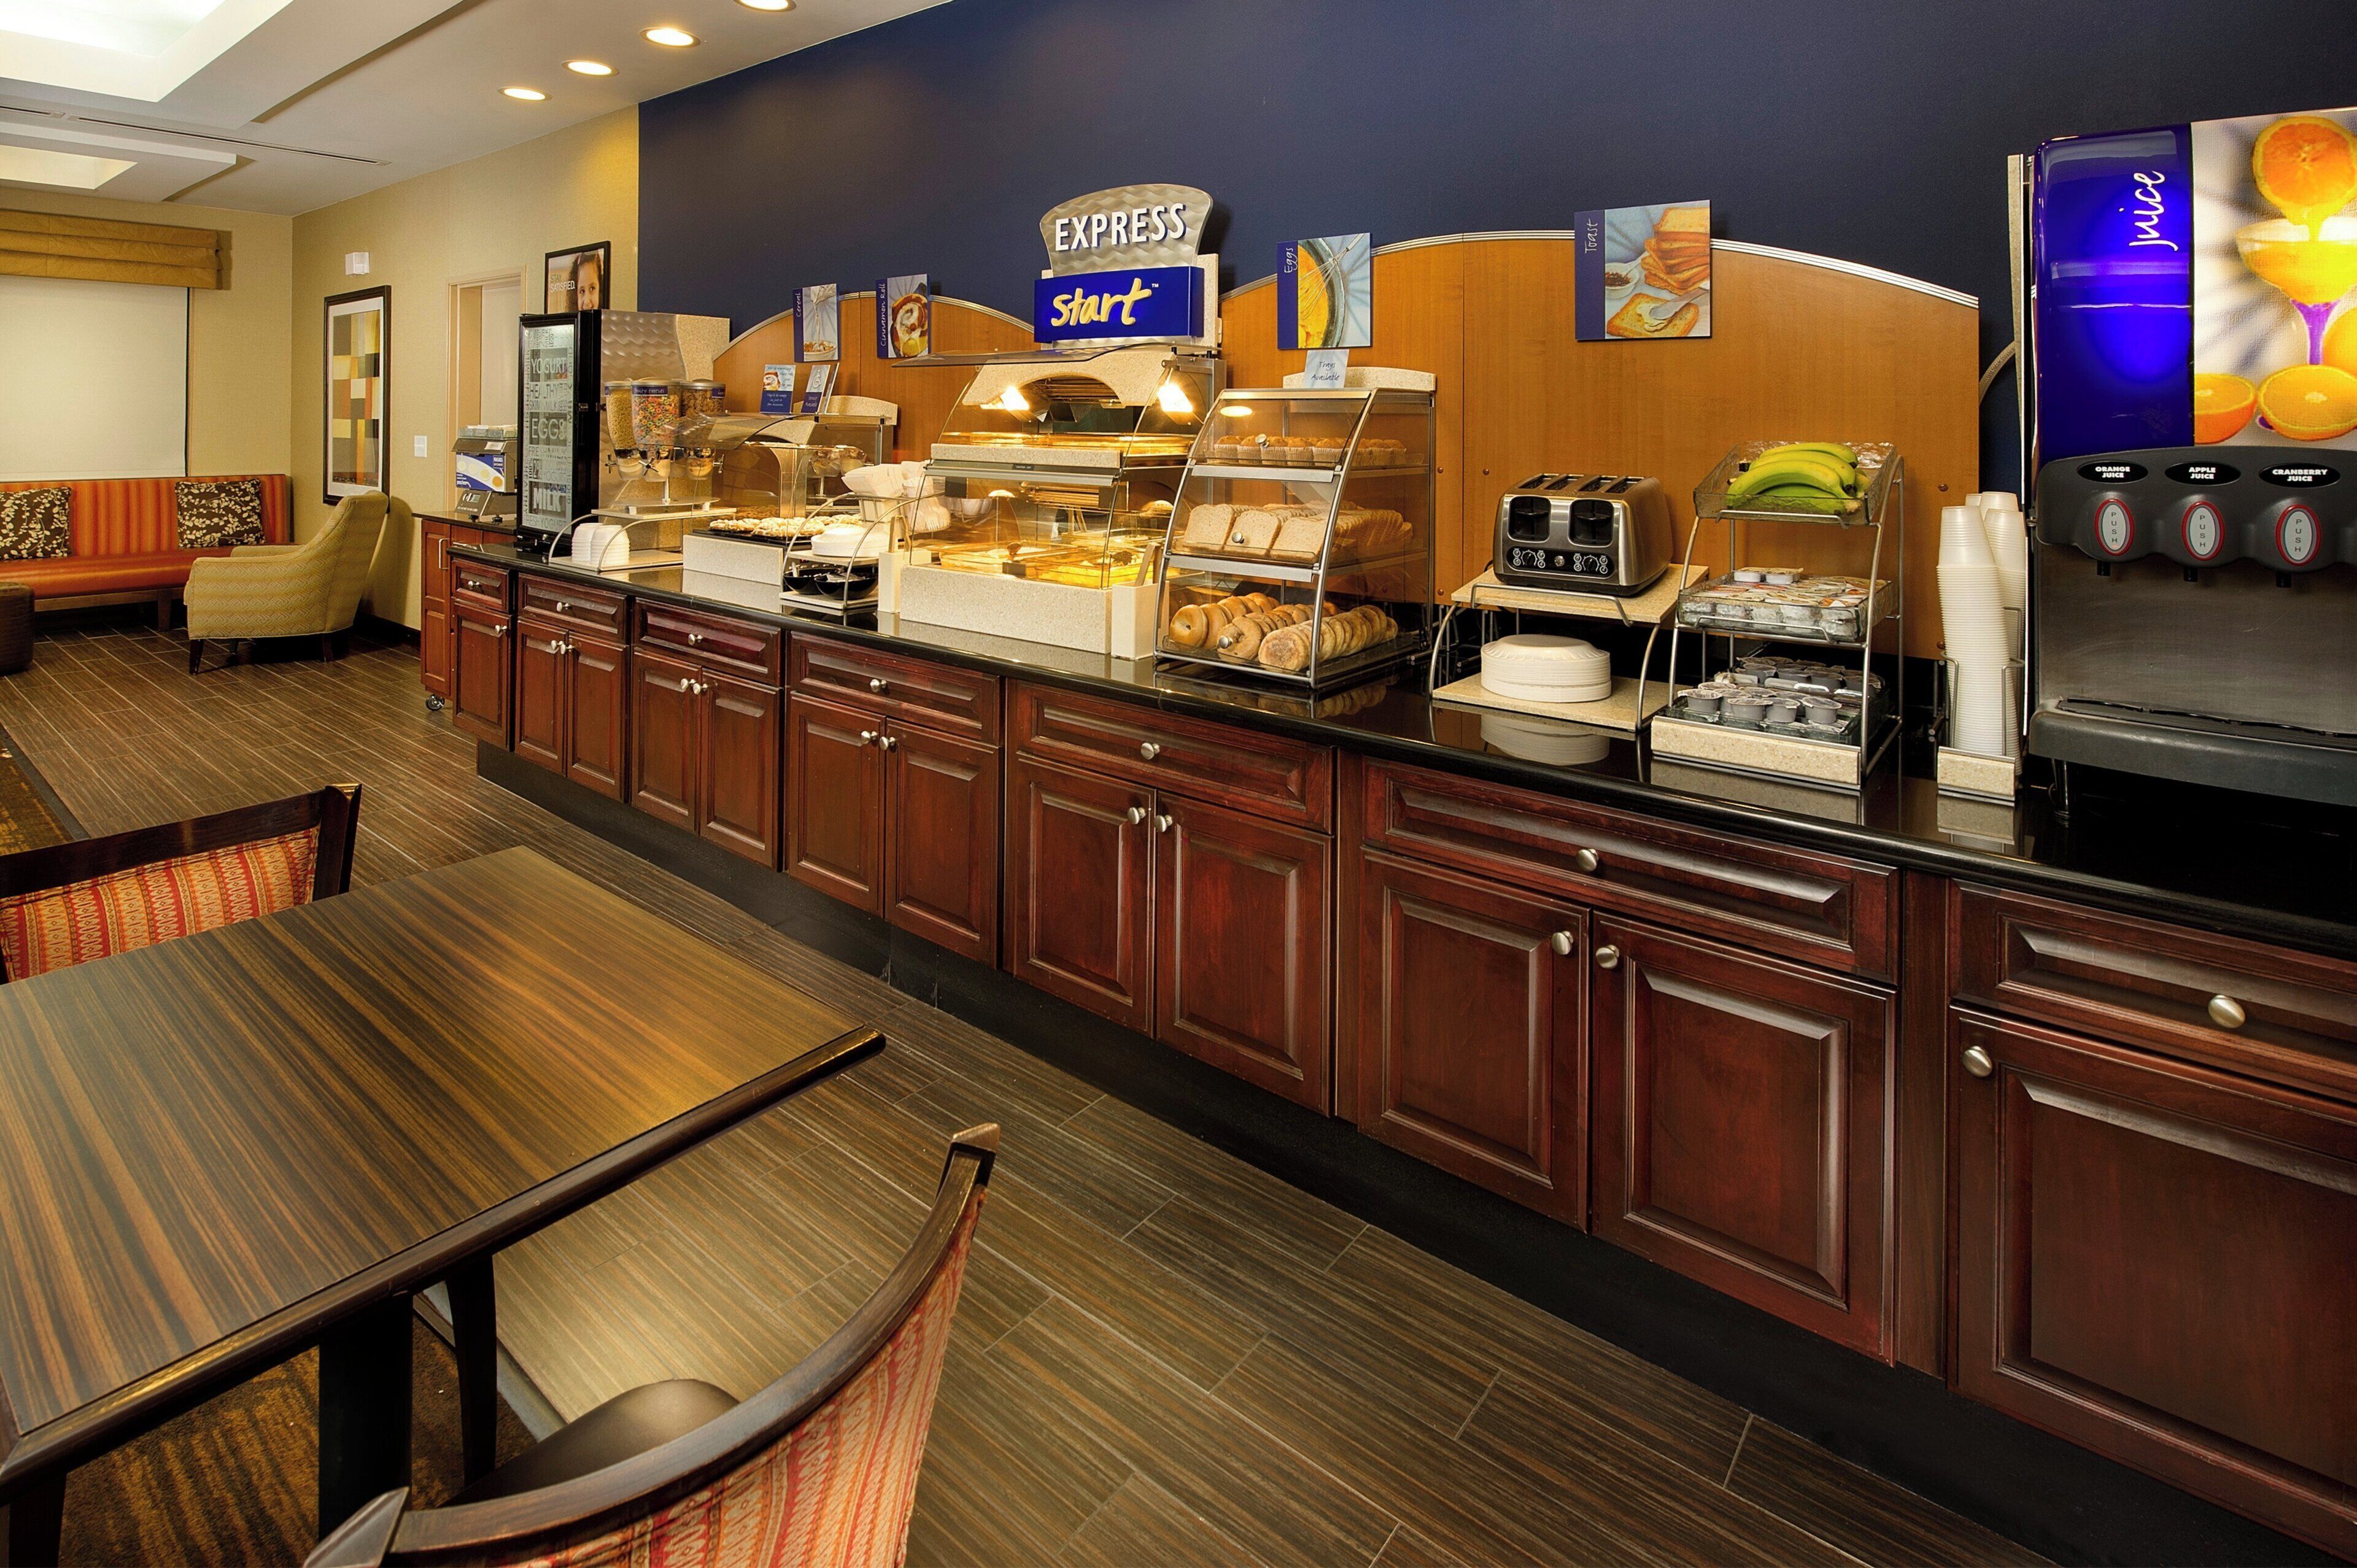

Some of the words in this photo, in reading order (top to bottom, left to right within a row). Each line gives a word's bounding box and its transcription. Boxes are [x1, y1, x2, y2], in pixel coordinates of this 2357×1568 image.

[2119, 171, 2178, 251] juice
[1056, 203, 1185, 252] EXPRESS
[1585, 218, 1598, 253] Toast
[1284, 247, 1298, 273] Eggs
[551, 274, 561, 282] STAY
[1051, 277, 1152, 326] start
[531, 357, 567, 374] YOGURT
[1311, 372, 1339, 381] Available
[1319, 361, 1336, 371] Trays
[532, 419, 565, 440] EGGS
[533, 488, 562, 512] MILK
